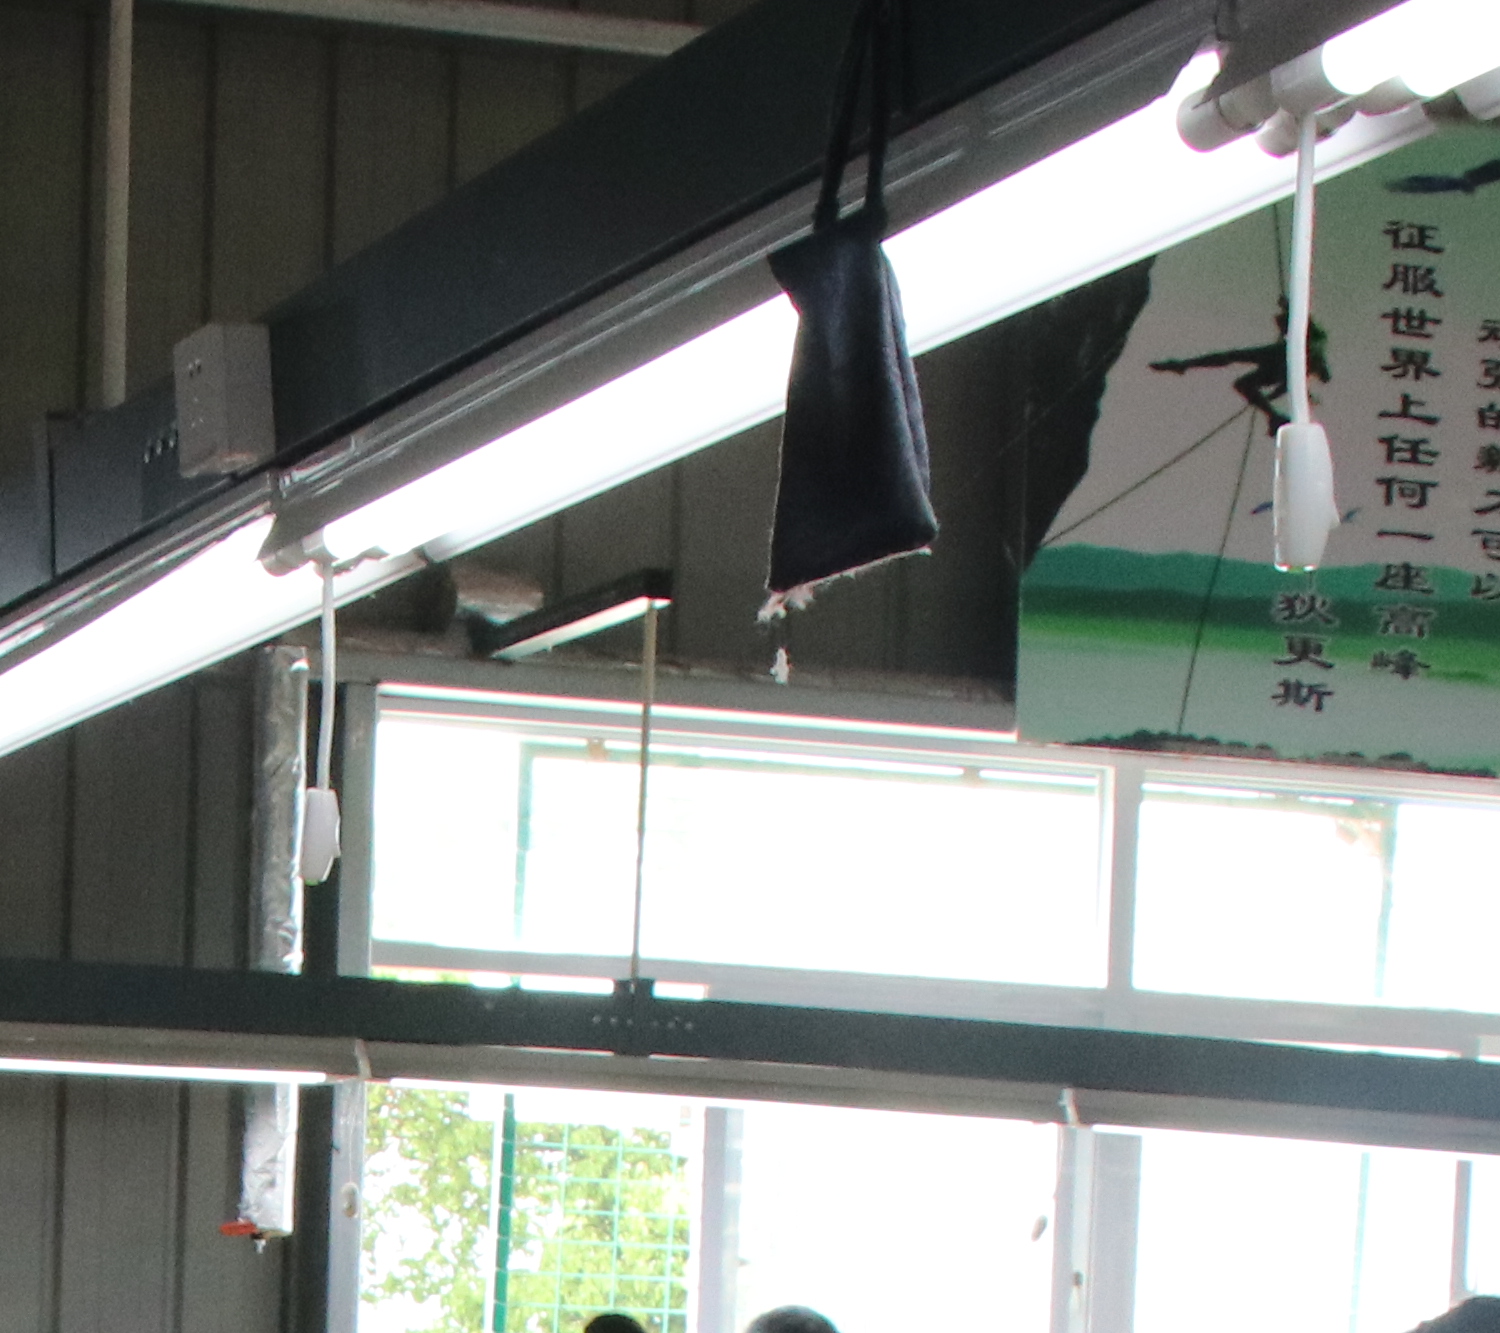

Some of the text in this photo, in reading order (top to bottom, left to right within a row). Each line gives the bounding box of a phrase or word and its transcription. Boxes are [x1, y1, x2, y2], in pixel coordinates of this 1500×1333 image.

[1370, 219, 1446, 682] 征服世界上任何一座高峰
[1270, 591, 1338, 714] 狄更斯
